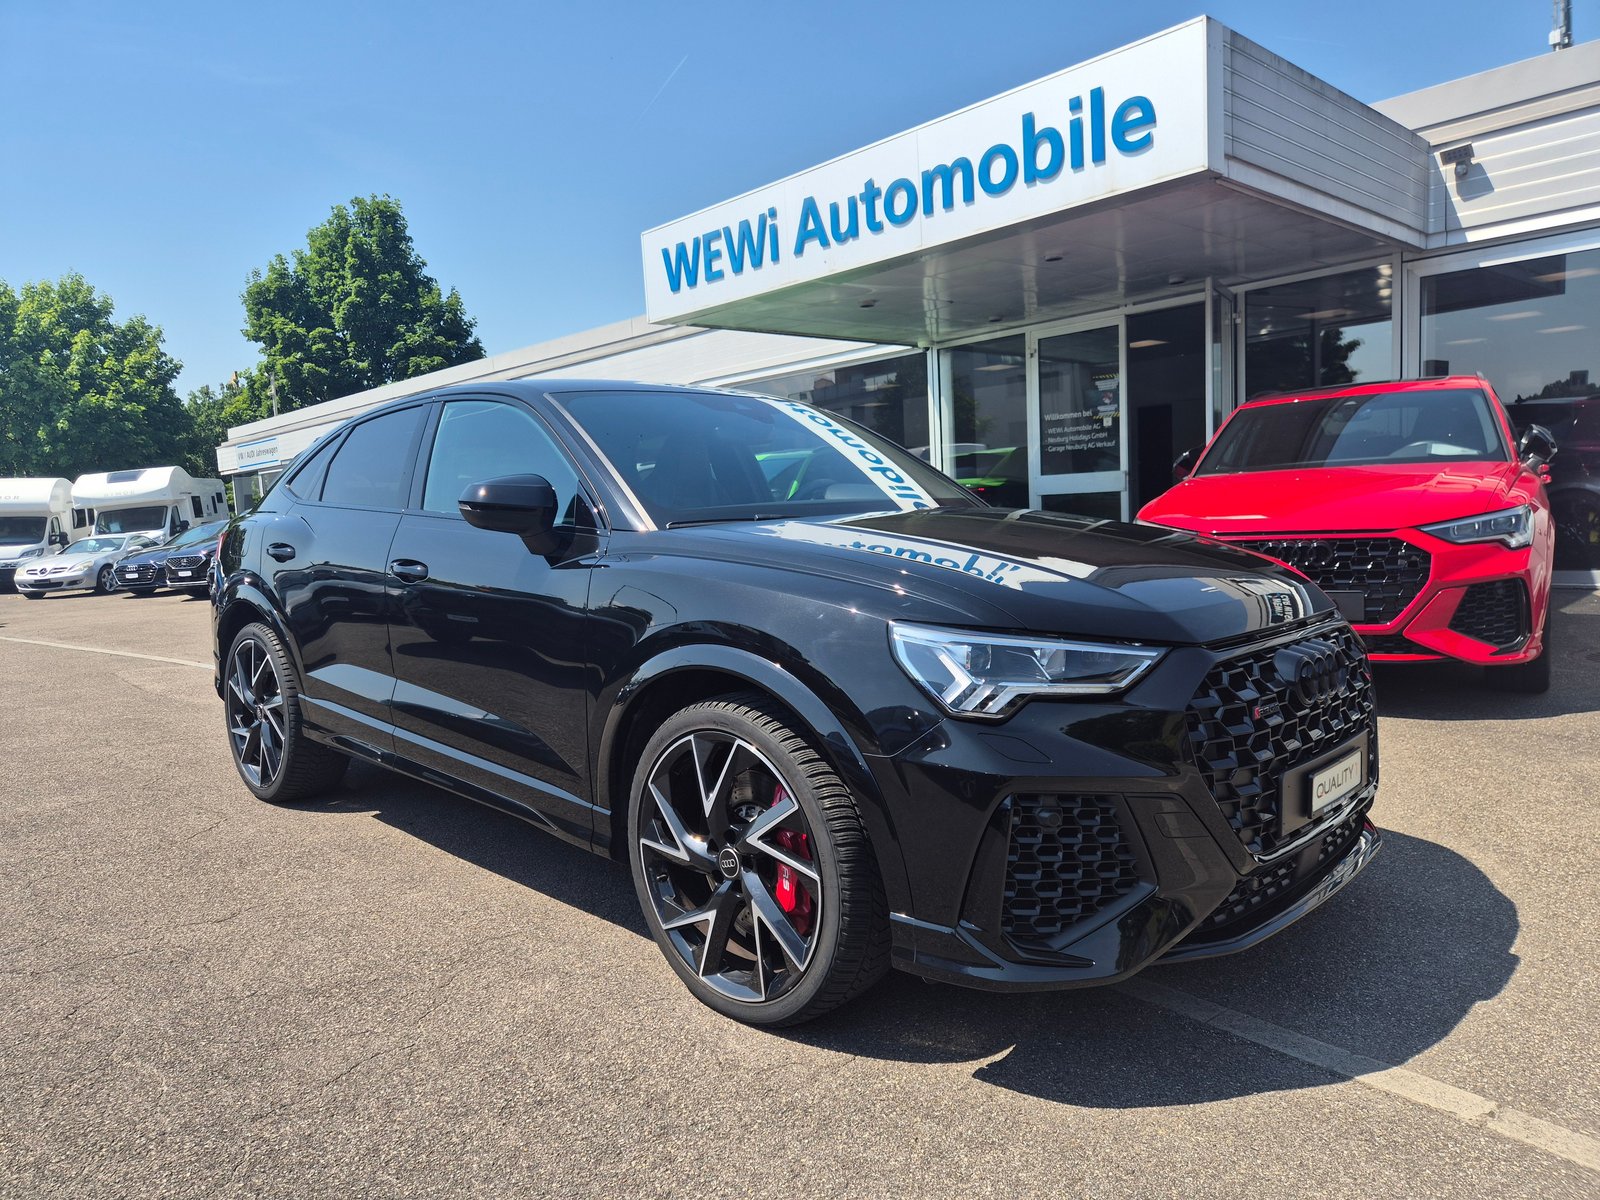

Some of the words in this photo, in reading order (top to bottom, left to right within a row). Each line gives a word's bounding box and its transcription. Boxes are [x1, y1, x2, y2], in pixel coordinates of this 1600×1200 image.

[661, 206, 780, 294] WEWi
[793, 86, 1157, 257] Automobile
[1044, 411, 1082, 421] Willkommen
[1082, 409, 1093, 417] bei
[1064, 424, 1092, 433] Automobile
[1048, 436, 1069, 444] Neuburg
[1069, 433, 1091, 442] Holidays
[1091, 431, 1108, 440] GmbH
[1048, 445, 1066, 453] Garage
[1066, 443, 1088, 451] Neuburg
[1096, 440, 1116, 448] Verkauf
